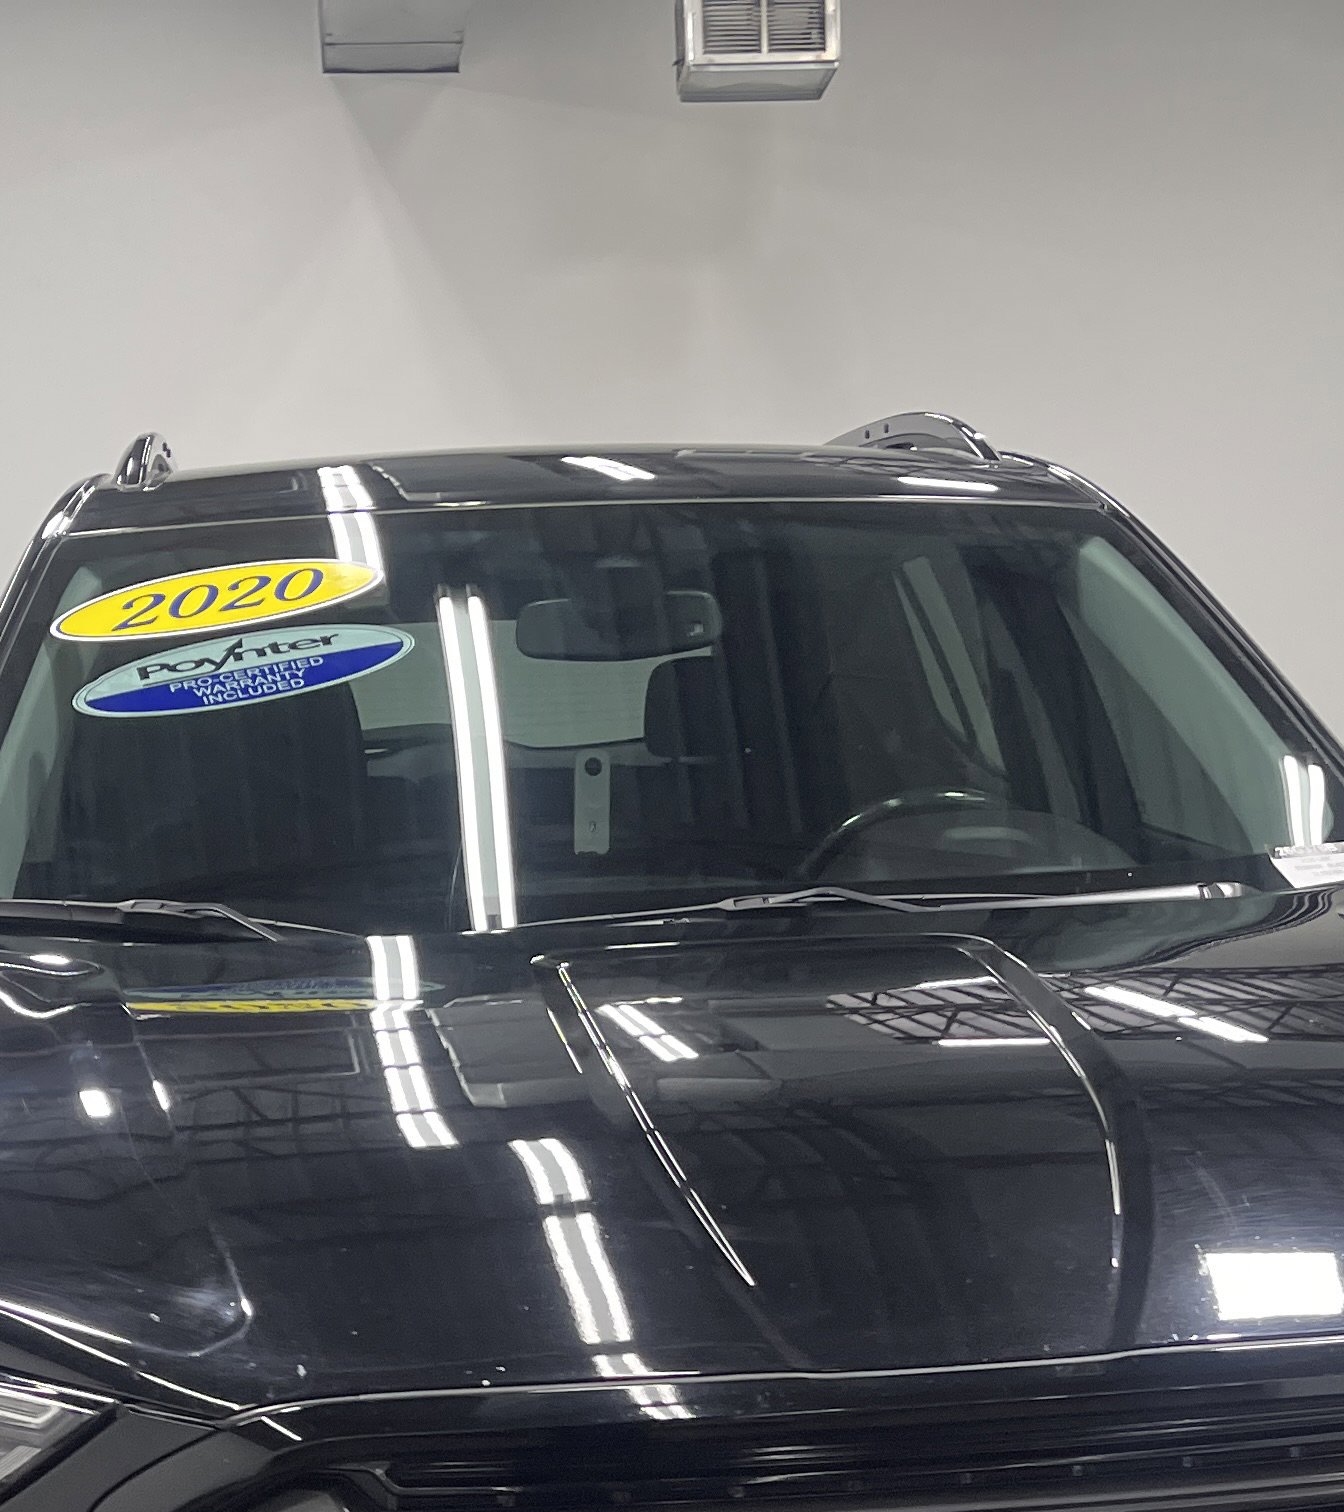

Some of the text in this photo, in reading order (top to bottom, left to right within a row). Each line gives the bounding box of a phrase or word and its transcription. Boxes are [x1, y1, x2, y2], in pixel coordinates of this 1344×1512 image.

[111, 567, 324, 631] 2020
[136, 633, 339, 681] Poynter
[169, 656, 324, 693] PRO-CERTIFIED
[192, 668, 305, 697] WARRANTY
[202, 679, 305, 705] INCLUDED
